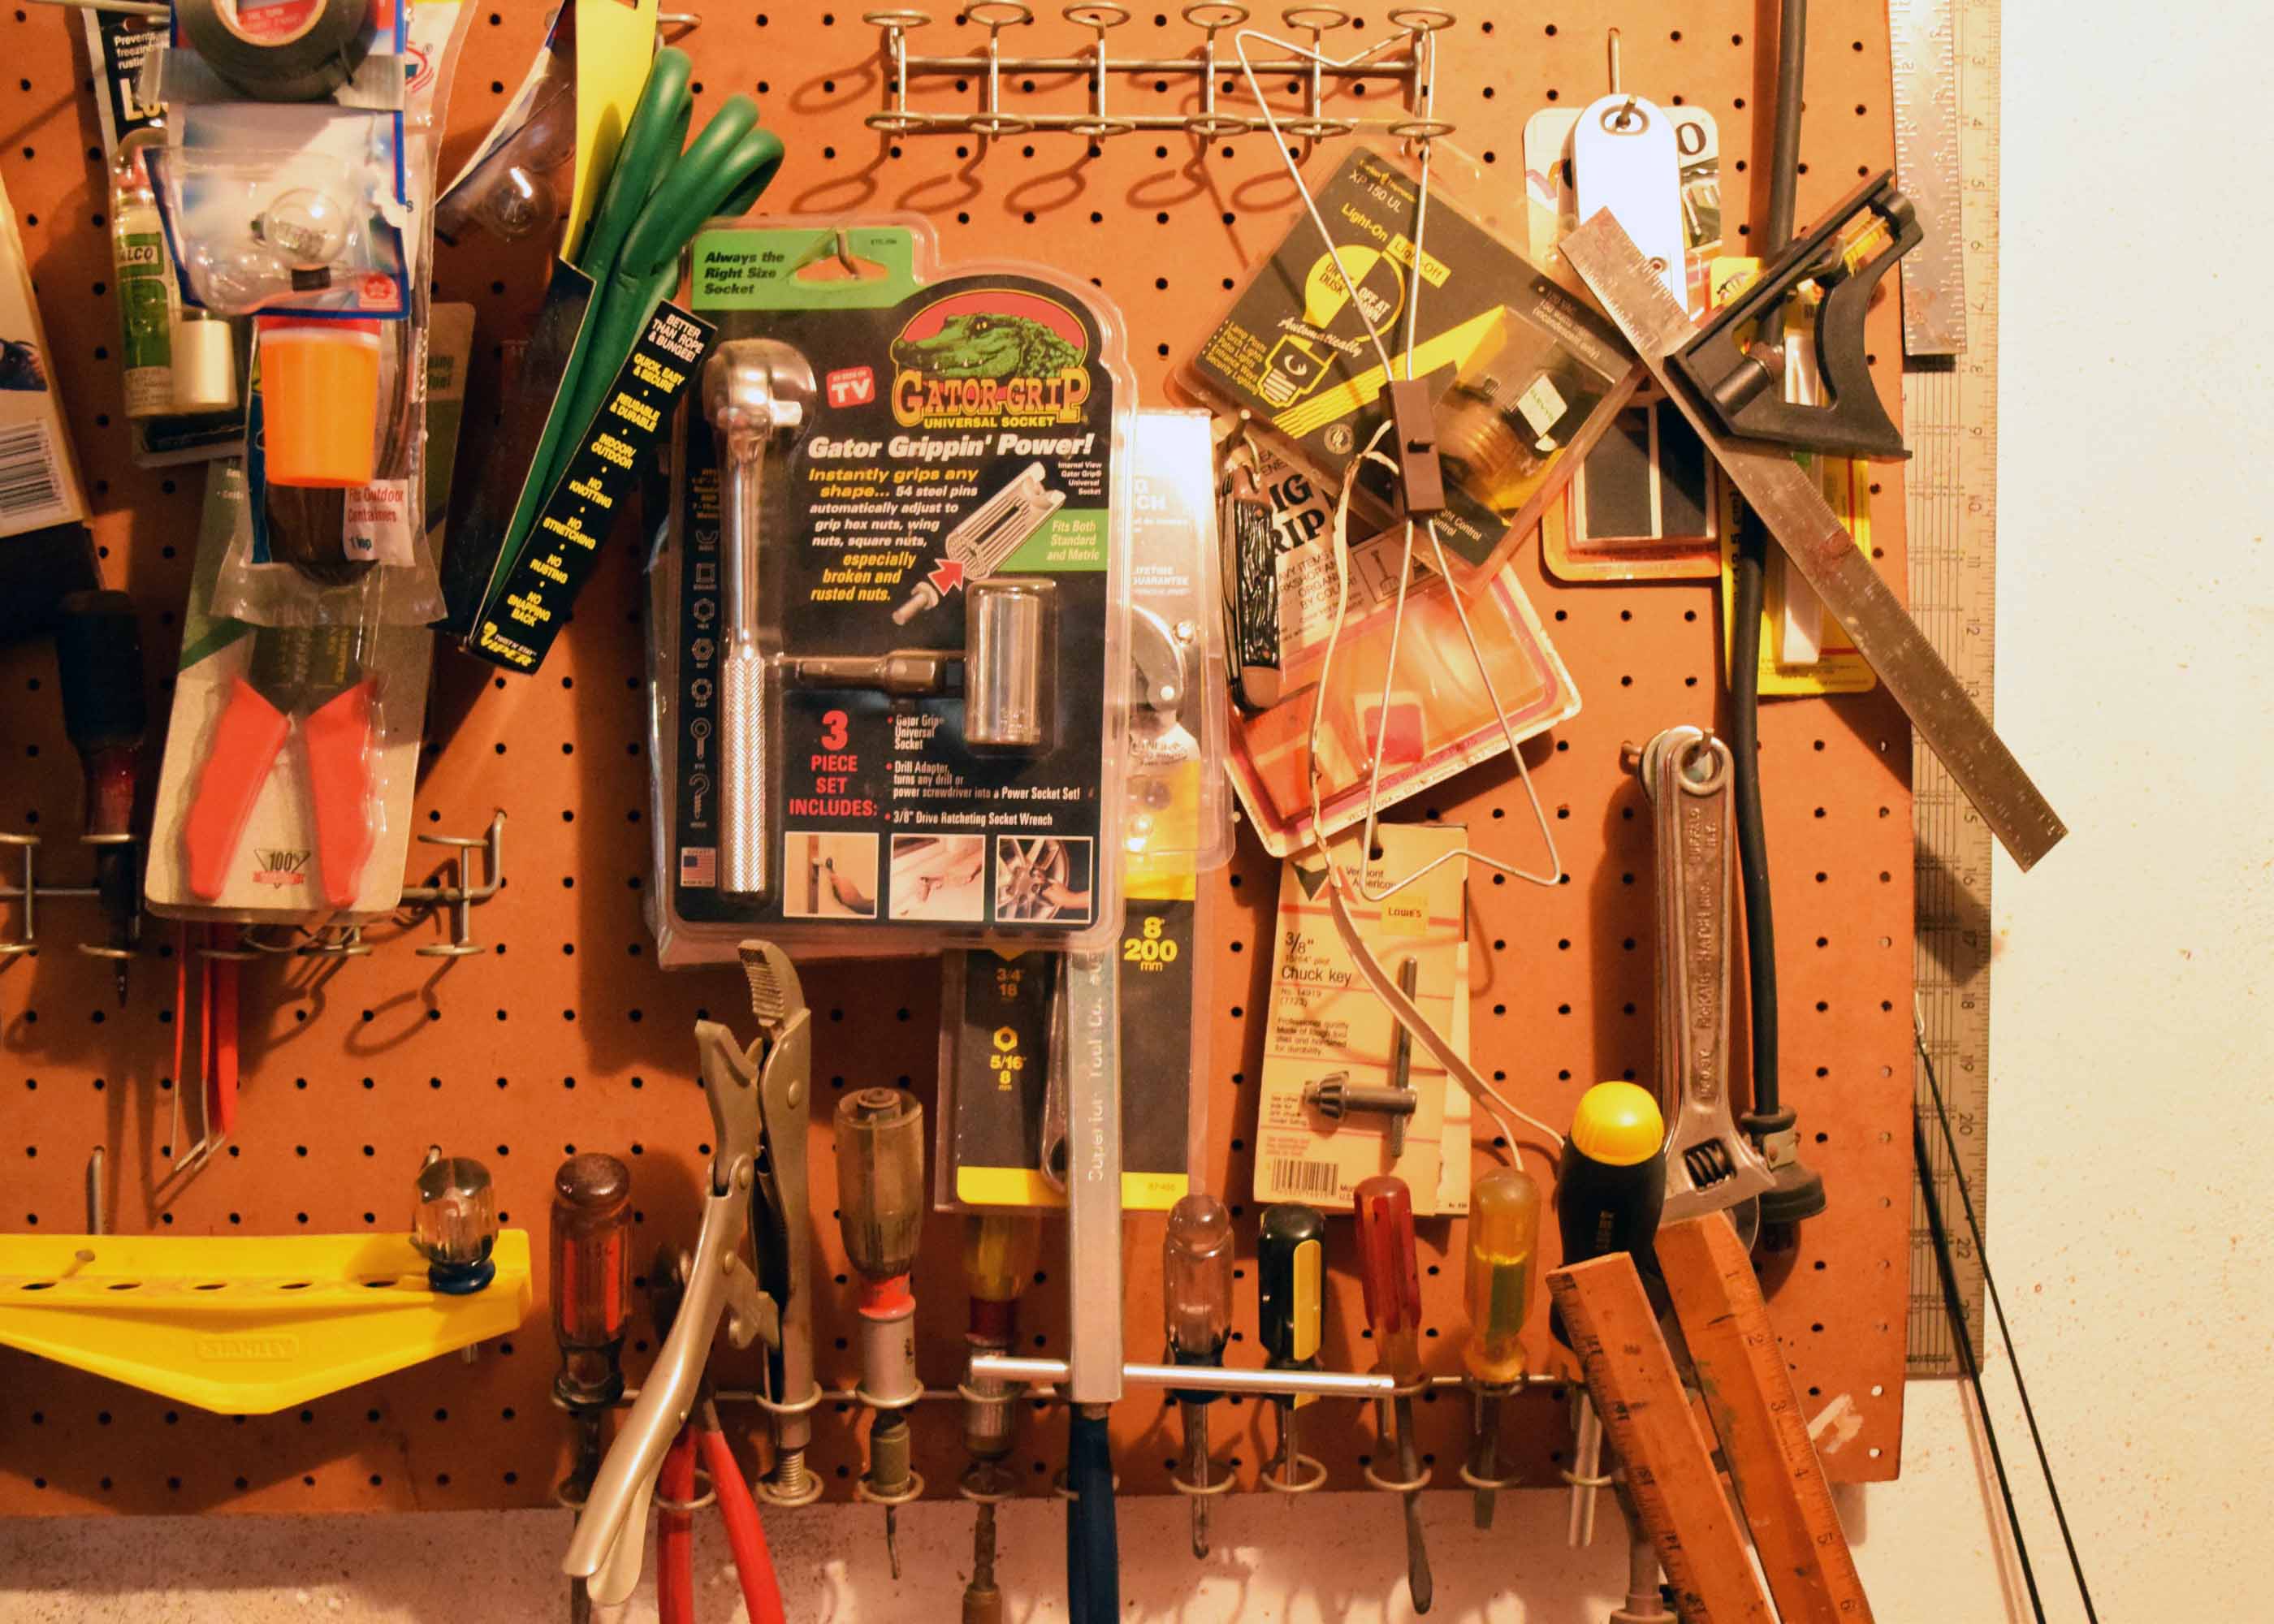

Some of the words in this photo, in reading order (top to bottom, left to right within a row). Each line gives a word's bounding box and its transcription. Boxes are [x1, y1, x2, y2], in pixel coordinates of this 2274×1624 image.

[1366, 181, 1388, 201] 150
[1386, 192, 1404, 214] UL
[1341, 202, 1389, 243] Light-On
[705, 251, 756, 266] Always
[762, 251, 785, 263] the
[704, 267, 742, 281] Right
[746, 267, 776, 279] Size
[704, 283, 754, 295] Socket
[1357, 286, 1379, 304] OFF
[1377, 299, 1391, 313] AT
[667, 313, 702, 339] BETTER
[652, 318, 678, 340] THAN
[678, 333, 705, 354] ROPE
[1277, 316, 1363, 358] Automatically
[648, 331, 656, 342] &
[655, 335, 696, 363] BUNGEE!
[633, 352, 662, 375] QUICK,
[662, 366, 685, 386] EASY
[640, 368, 676, 394] SECURE
[831, 378, 871, 404] TV
[616, 391, 661, 421] REUSABLE
[617, 403, 657, 433] DURABLE
[923, 416, 998, 430] UNIVERSAL
[1001, 415, 1055, 428] SOCKET
[808, 436, 883, 460] Gator
[888, 434, 992, 461] Grippin'
[996, 431, 1096, 456] Power!
[590, 442, 633, 469] OUTDOOR
[1085, 460, 1102, 469] View
[808, 468, 889, 482] Instantly
[893, 468, 940, 484] grips
[945, 468, 979, 482] any
[1061, 469, 1080, 477] Gator
[1068, 478, 1100, 486] Universal
[587, 476, 603, 491] NO
[819, 485, 890, 499] shape...
[915, 486, 947, 498] steel
[949, 486, 978, 499] pins
[1078, 487, 1101, 495] Socket
[363, 487, 404, 503] Outdoor
[568, 479, 613, 509] KNOTTING
[1268, 473, 1314, 513] IG
[348, 507, 397, 525] Containers
[809, 502, 898, 516] automatically
[901, 502, 942, 516] adjust
[945, 503, 959, 513] to
[567, 516, 582, 530] NO
[815, 518, 841, 532] grip
[844, 518, 867, 530] hex
[871, 519, 903, 532] nuts,
[907, 519, 940, 533] wing
[1053, 519, 1070, 532] Fits
[1072, 519, 1096, 532] Both
[1270, 509, 1325, 555] RIP
[1454, 516, 1483, 542] Control
[543, 516, 596, 551] STRETCHING
[812, 536, 845, 548] nuts,
[848, 537, 892, 548] square
[895, 536, 927, 548] nuts,
[1051, 533, 1096, 546] Standard
[547, 553, 562, 568] NO
[842, 551, 917, 569] especially
[1047, 549, 1066, 561] and
[1068, 548, 1100, 561] Metric
[530, 558, 568, 584] RUSTING
[822, 568, 871, 584] broken
[874, 569, 902, 584] and
[527, 590, 543, 606] NO
[811, 585, 857, 601] rusted
[857, 588, 891, 601] nuts.
[507, 594, 551, 622] SNAPPING
[511, 608, 538, 627] BACK
[1965, 617, 1981, 637] 12
[896, 714, 919, 726] Gator
[821, 710, 849, 751] 3
[894, 727, 936, 738] Universal
[895, 739, 923, 750] Socket
[811, 754, 858, 772] PIECE
[894, 761, 913, 773] Drill
[815, 776, 848, 795] SET
[893, 774, 914, 786] turns
[918, 776, 932, 788] any
[936, 775, 953, 786] drill
[955, 776, 964, 786] or
[893, 787, 920, 800] power
[923, 787, 972, 799] screwdriver
[975, 788, 991, 799] into
[993, 791, 1000, 800] a
[1001, 786, 1029, 800] Power
[1031, 786, 1061, 800] Socket
[1062, 787, 1080, 801] Set!
[789, 798, 878, 817] INCLUDES:
[893, 810, 914, 824] 3/8"
[915, 811, 939, 824] Drive
[941, 812, 986, 827] Ratcheting
[988, 812, 1018, 826] Socket
[1020, 813, 1053, 827] Wrench
[1346, 866, 1384, 878] Veront
[1962, 866, 1978, 887] 16
[1123, 937, 1178, 962] 200
[1285, 931, 1314, 955] 3/8"
[1140, 961, 1163, 972] mm
[1281, 964, 1323, 982] Chuck
[1329, 969, 1351, 987] key
[1961, 991, 1976, 1011] 18
[1089, 997, 1104, 1028] Co.
[1088, 1039, 1104, 1077] Tool
[998, 1070, 1012, 1085] 8
[1958, 1112, 1974, 1136] 20
[1087, 1094, 1106, 1182] Superior
[1956, 1237, 1971, 1259] 22
